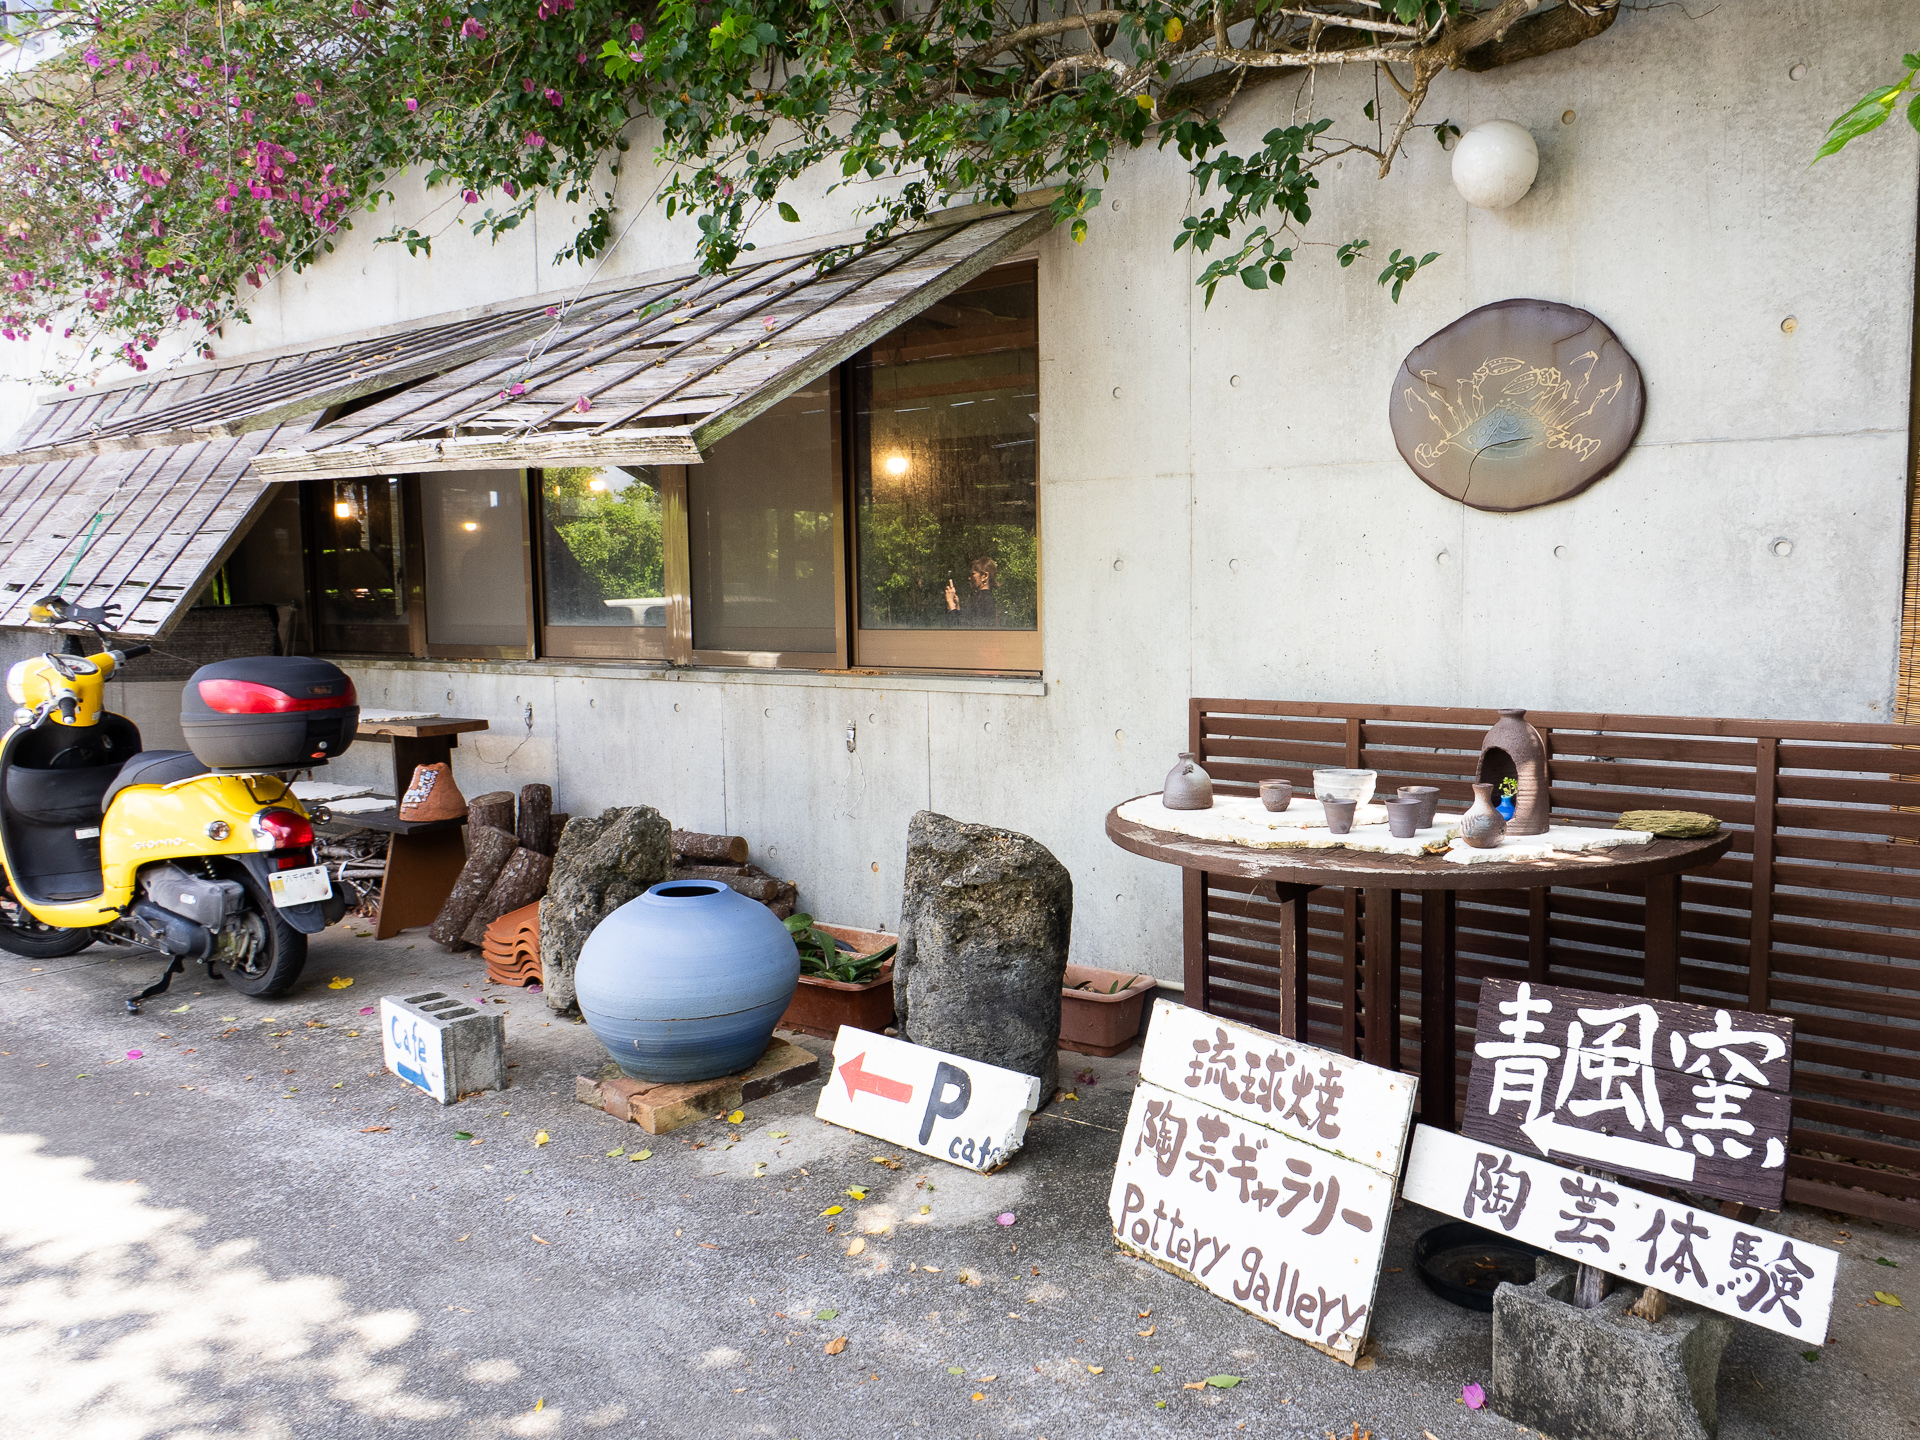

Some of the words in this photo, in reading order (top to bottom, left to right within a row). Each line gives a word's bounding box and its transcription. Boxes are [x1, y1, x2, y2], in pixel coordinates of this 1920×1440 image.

[391, 1015, 427, 1063] Cafe
[918, 1061, 972, 1145] P
[1184, 1027, 1344, 1139] 琉球焼
[1475, 981, 1786, 1168] 青風窯
[1135, 1100, 1373, 1235] 陶芸ギャラリー
[1118, 1183, 1231, 1277] Pottery
[1233, 1247, 1366, 1347] gallery
[1463, 1152, 1814, 1328] 陶芸体験
